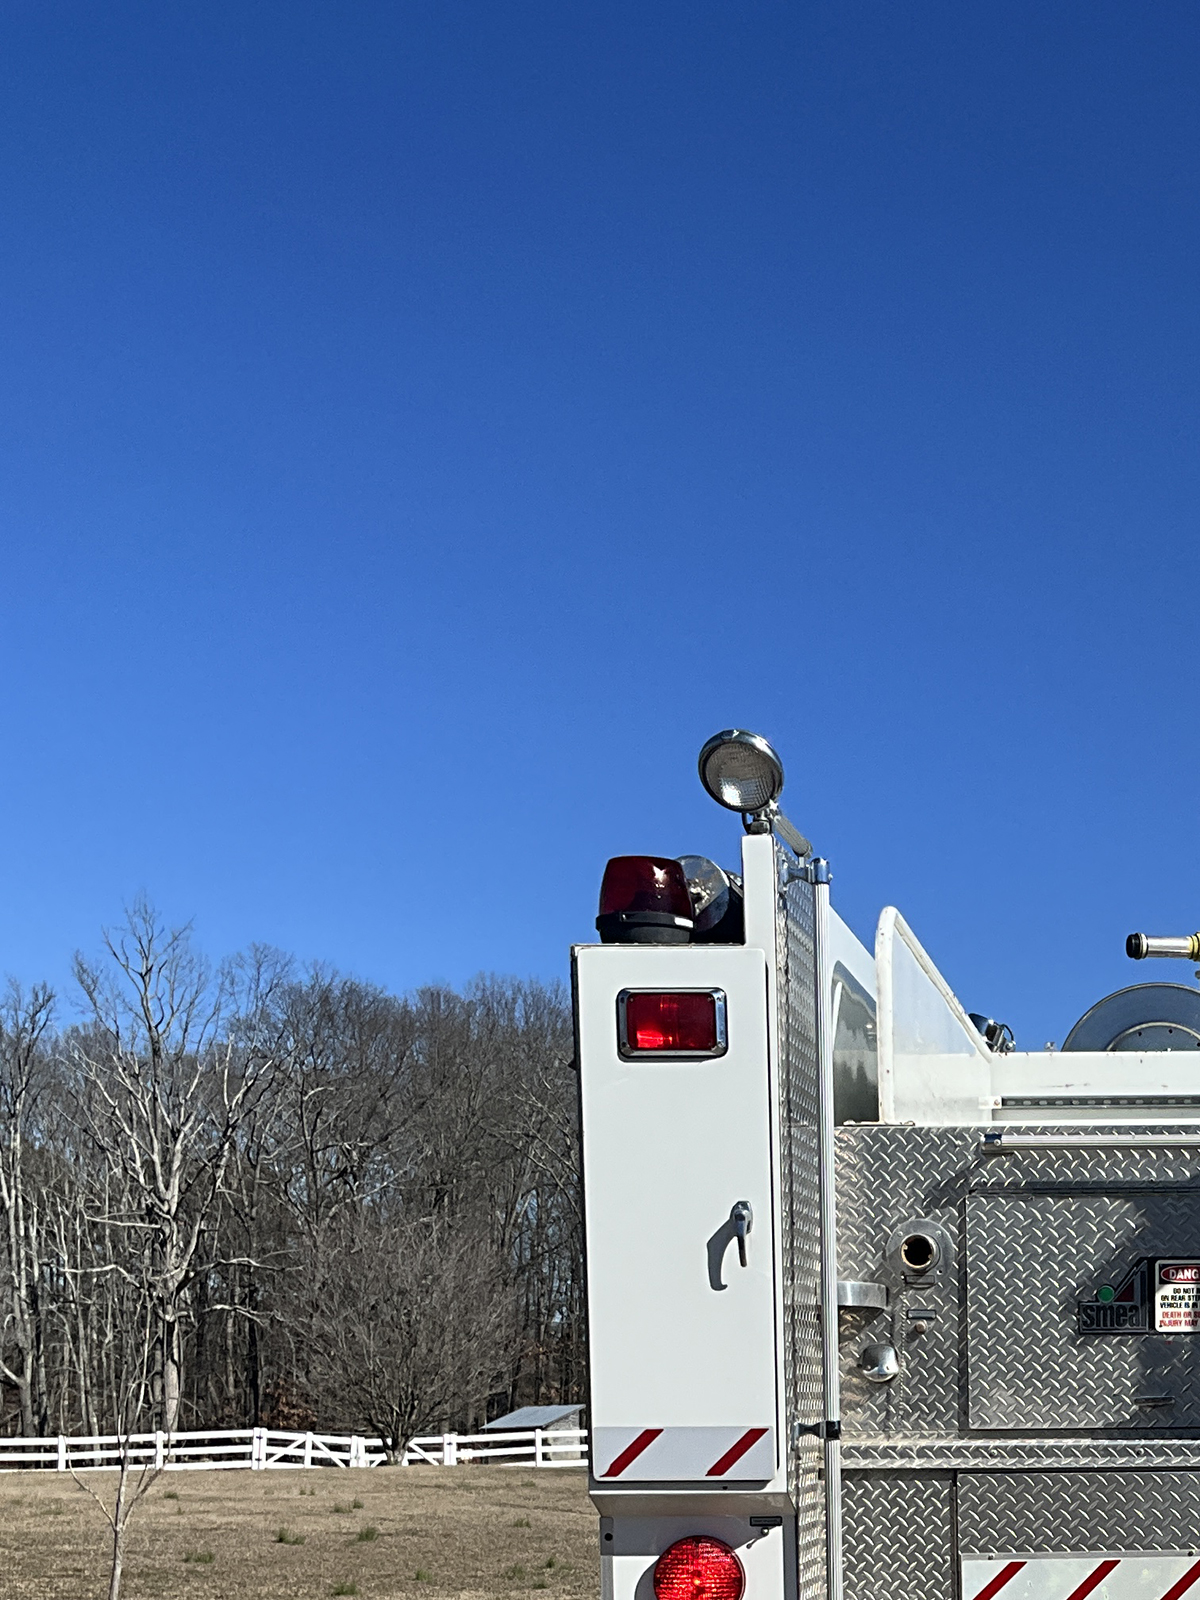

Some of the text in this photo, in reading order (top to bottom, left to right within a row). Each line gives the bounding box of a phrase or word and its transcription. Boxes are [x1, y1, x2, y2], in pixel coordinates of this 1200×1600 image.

[1082, 1300, 1148, 1328] smeal
[1162, 1311, 1182, 1319] DEATH
[1183, 1311, 1192, 1319] OR
[1160, 1319, 1183, 1327] INJURY
[1184, 1319, 1199, 1327] MAY
